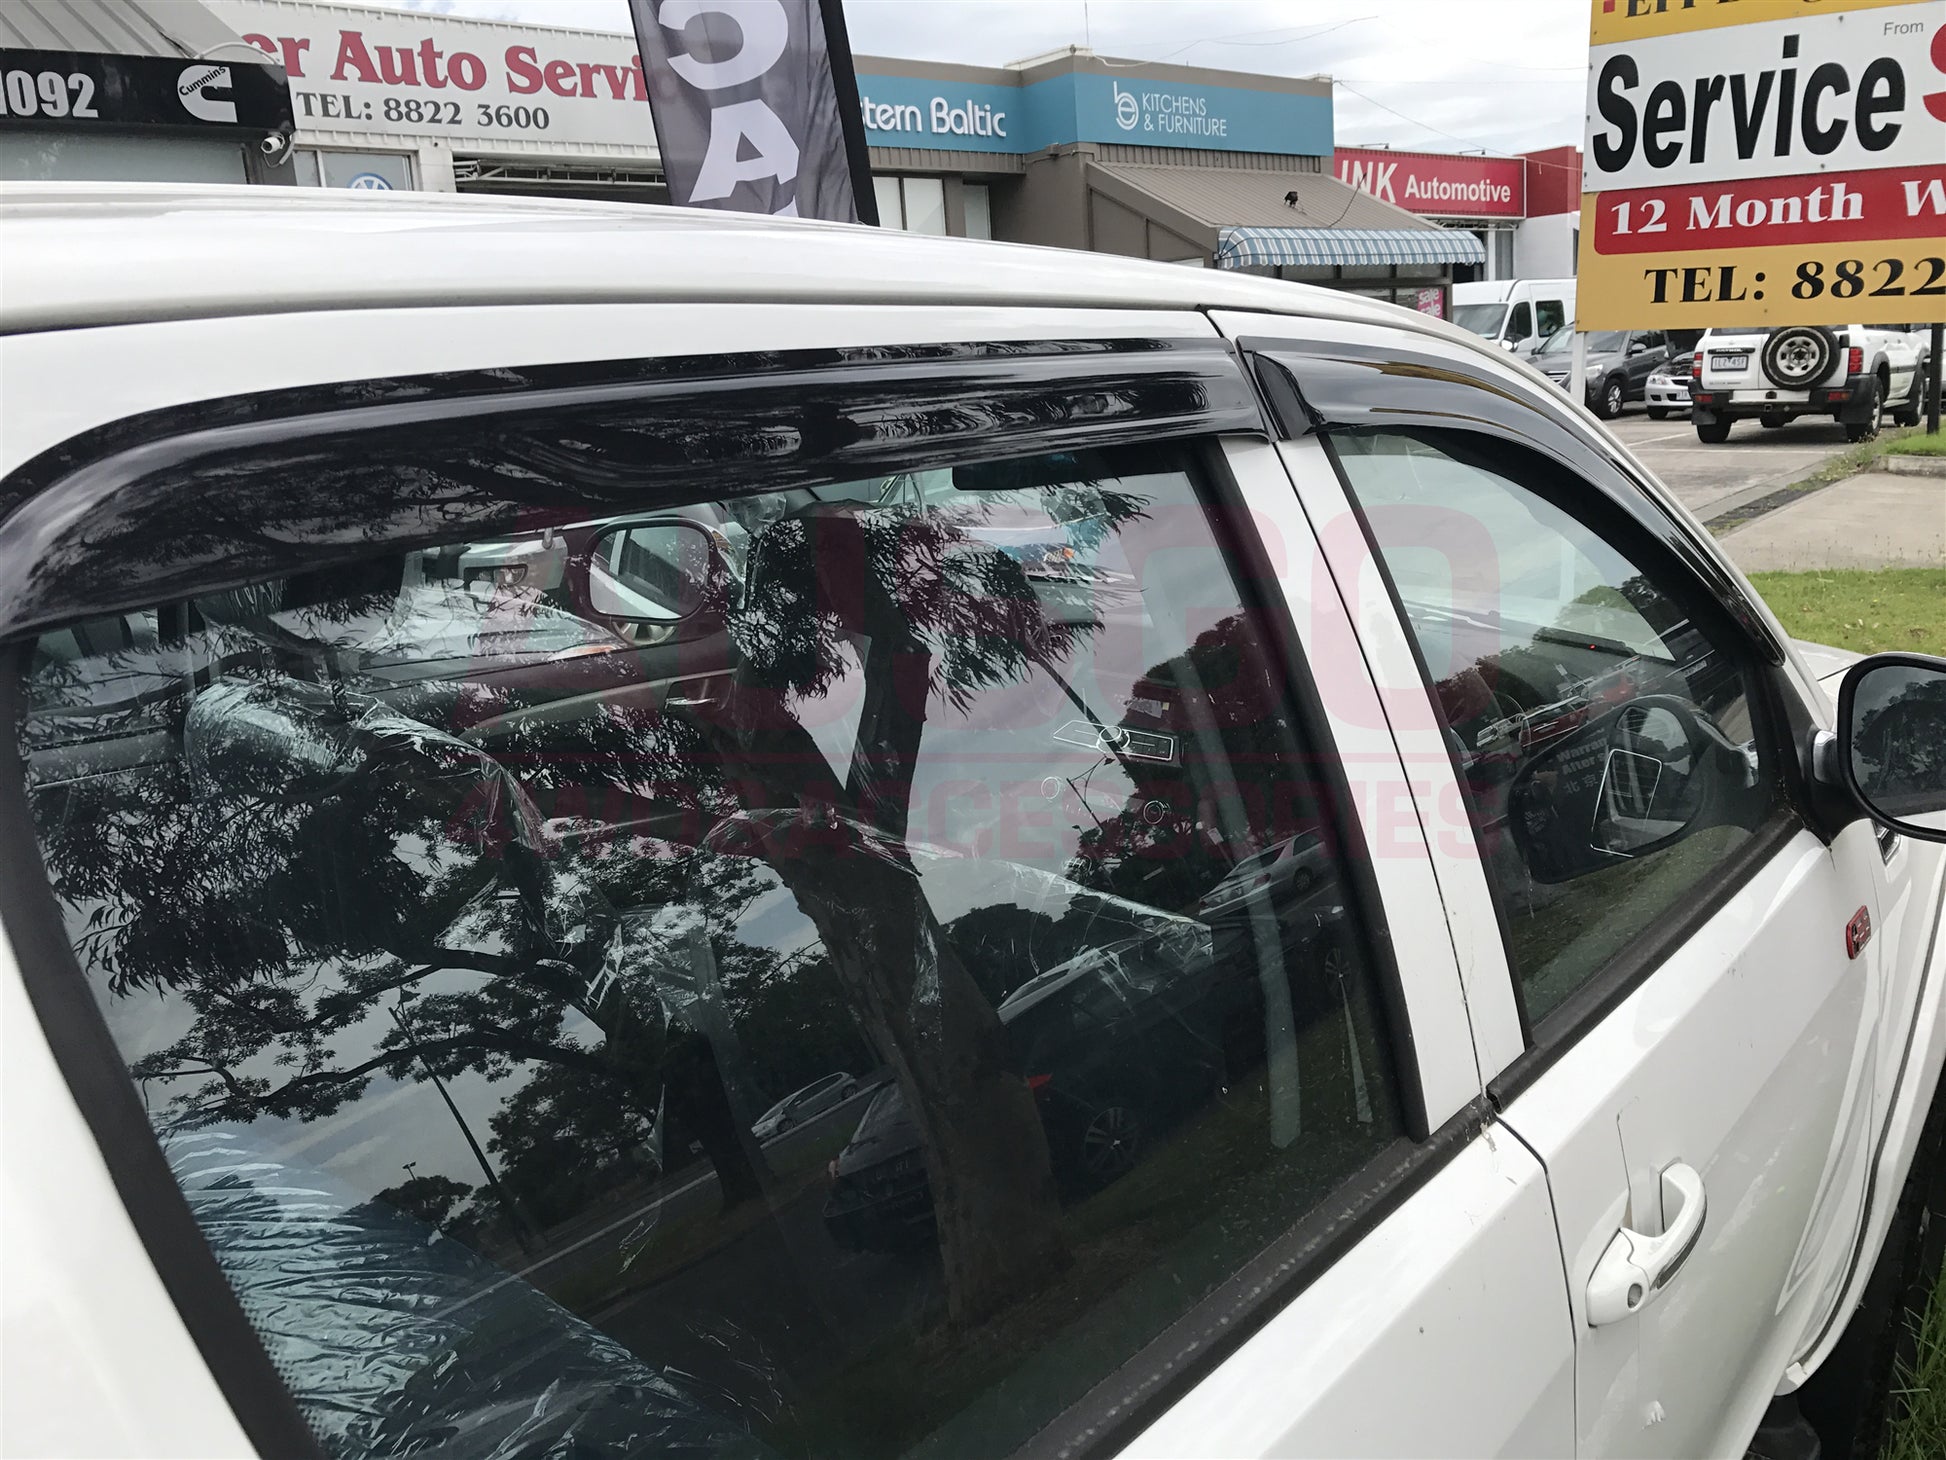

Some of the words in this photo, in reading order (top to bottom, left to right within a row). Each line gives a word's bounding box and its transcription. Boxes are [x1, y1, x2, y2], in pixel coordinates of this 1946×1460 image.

[1883, 21, 1924, 36] From
[178, 64, 227, 97] Cummins
[330, 29, 487, 91] Auto
[504, 45, 649, 102] Servi
[296, 91, 373, 120] TEL:
[383, 97, 462, 124] 8822
[477, 104, 549, 129] 3600
[929, 96, 1007, 137] Baltic
[1142, 92, 1207, 116] KITCHENS
[1592, 33, 1906, 173] Service
[1143, 113, 1154, 131] &
[1158, 114, 1227, 137] FURNITURE
[1404, 174, 1511, 203] Automotive
[1610, 198, 1667, 236] 12
[1686, 182, 1864, 231] Month
[1419, 287, 1440, 305] sale
[1643, 265, 1766, 304] TEL:
[1791, 257, 1946, 300] 8822
